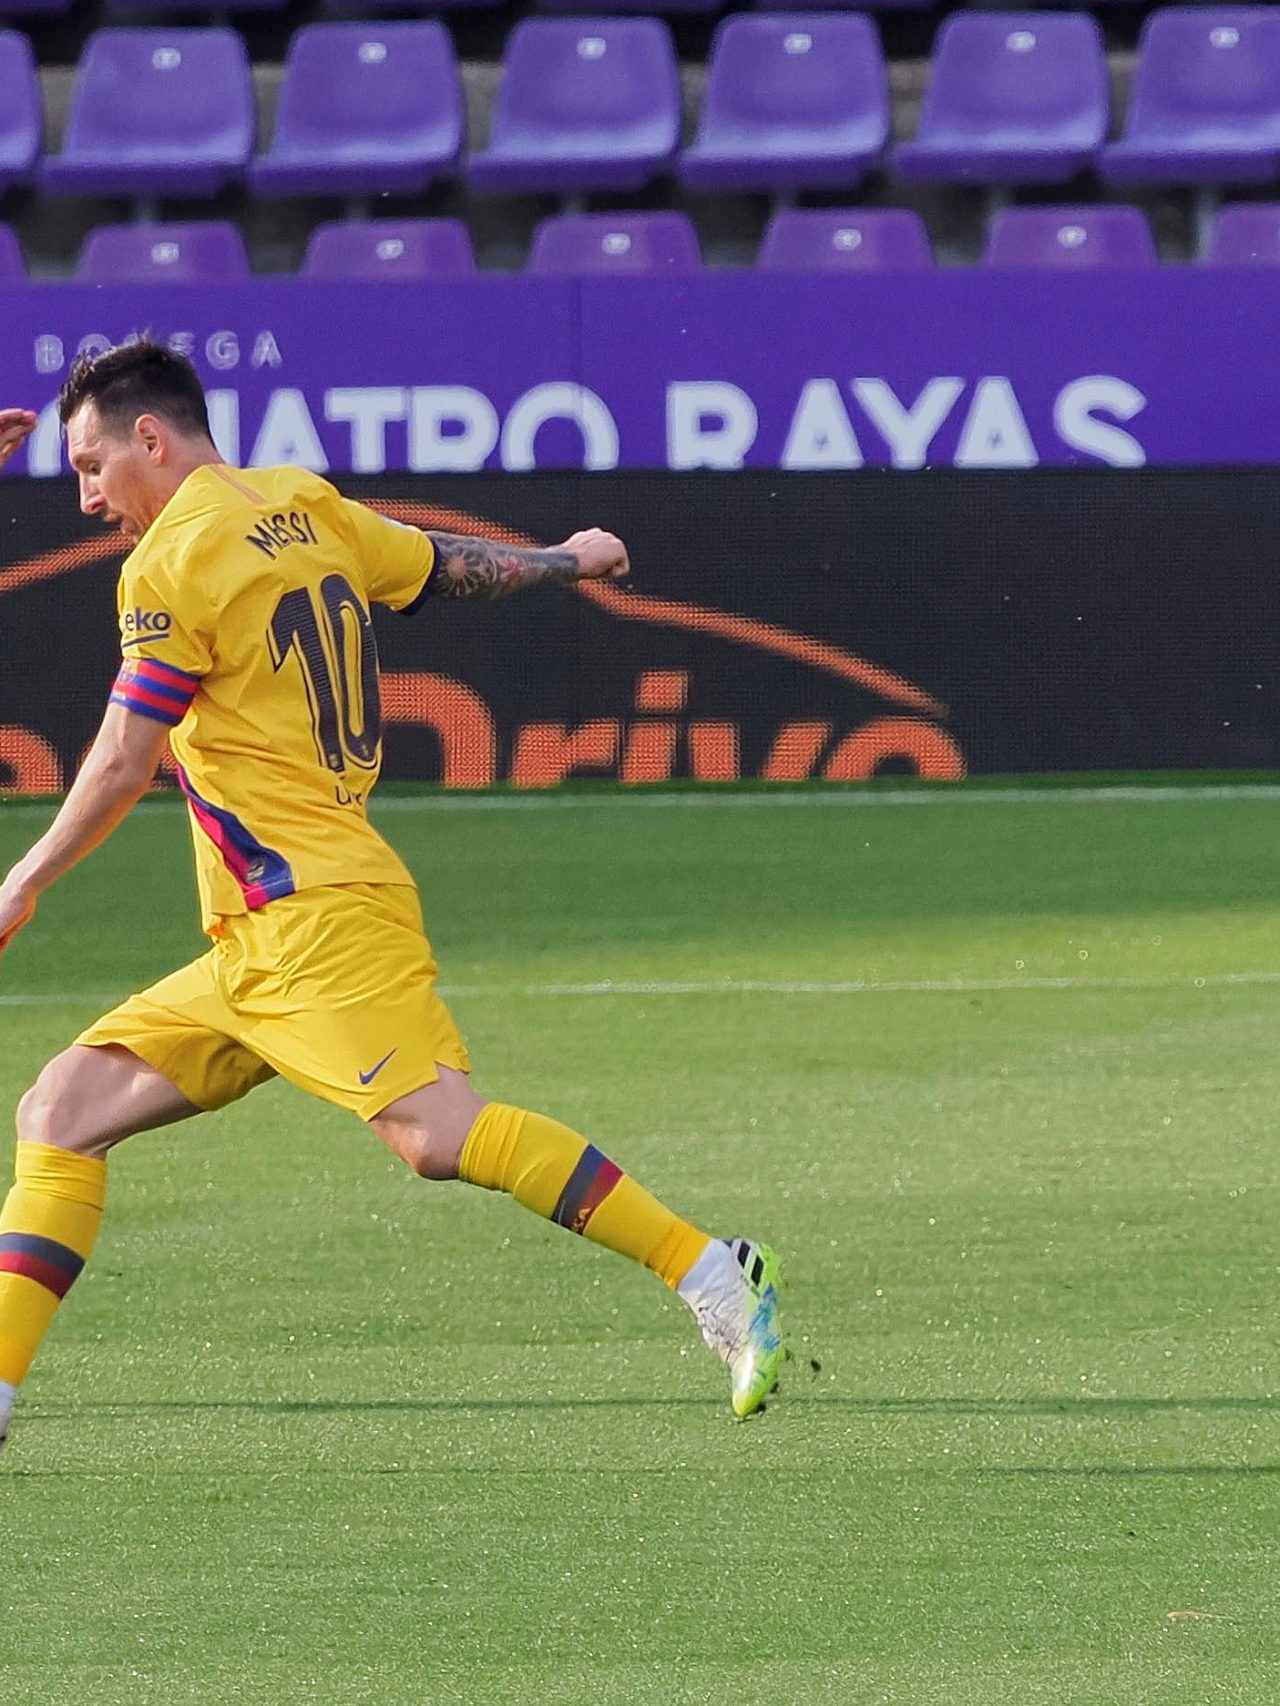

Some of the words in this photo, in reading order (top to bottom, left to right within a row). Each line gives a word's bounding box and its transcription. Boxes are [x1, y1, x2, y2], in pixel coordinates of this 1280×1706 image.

[665, 375, 1147, 471] RAYAS
[245, 511, 318, 561] MESSI
[125, 606, 171, 631] eko
[266, 573, 383, 773] 10
